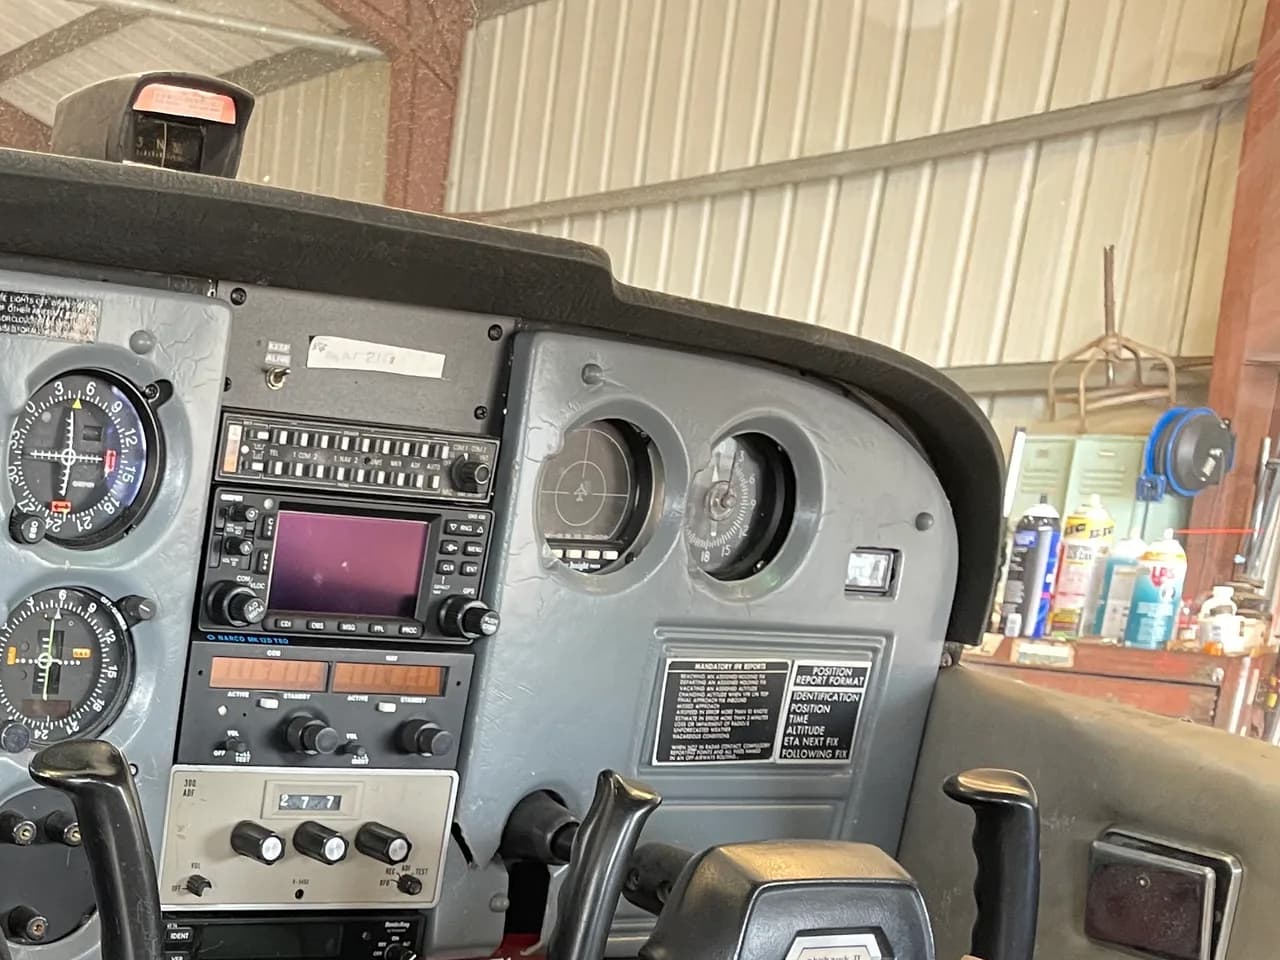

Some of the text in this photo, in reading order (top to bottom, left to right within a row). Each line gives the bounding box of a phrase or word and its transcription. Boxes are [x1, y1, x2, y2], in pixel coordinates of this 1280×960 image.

[54, 381, 64, 396] 3
[86, 382, 96, 396] 6
[111, 401, 123, 414] 9
[9, 430, 20, 450] 33
[124, 427, 138, 448] 12
[7, 465, 20, 485] 30
[121, 465, 136, 483] 15
[17, 499, 36, 513] 27
[103, 497, 120, 515] 18
[45, 516, 63, 533] 24
[76, 517, 93, 533] 21
[700, 550, 711, 563] 18
[721, 544, 731, 558] 15
[58, 589, 67, 601] 6
[88, 602, 97, 613] 9
[104, 629, 116, 644] 12
[218, 635, 246, 643] NARCO
[108, 664, 118, 679] 15
[812, 667, 852, 677] POSITION
[796, 675, 865, 687] REPORT FORMAT
[283, 693, 311, 701] STANDBY
[400, 697, 427, 705] STANDBY
[793, 691, 859, 702] IDENTIFICATION
[92, 699, 105, 713] 18
[790, 703, 831, 714] POSITION
[789, 714, 809, 724] TIME
[66, 720, 80, 735] 21
[786, 725, 825, 736] ALTITUDE
[34, 729, 49, 740] 24
[783, 736, 839, 747] ETA NEXT FIX
[781, 749, 848, 759] FOLLOWING FIX
[280, 795, 334, 808] 2 7 7
[170, 932, 189, 940] IDENT
